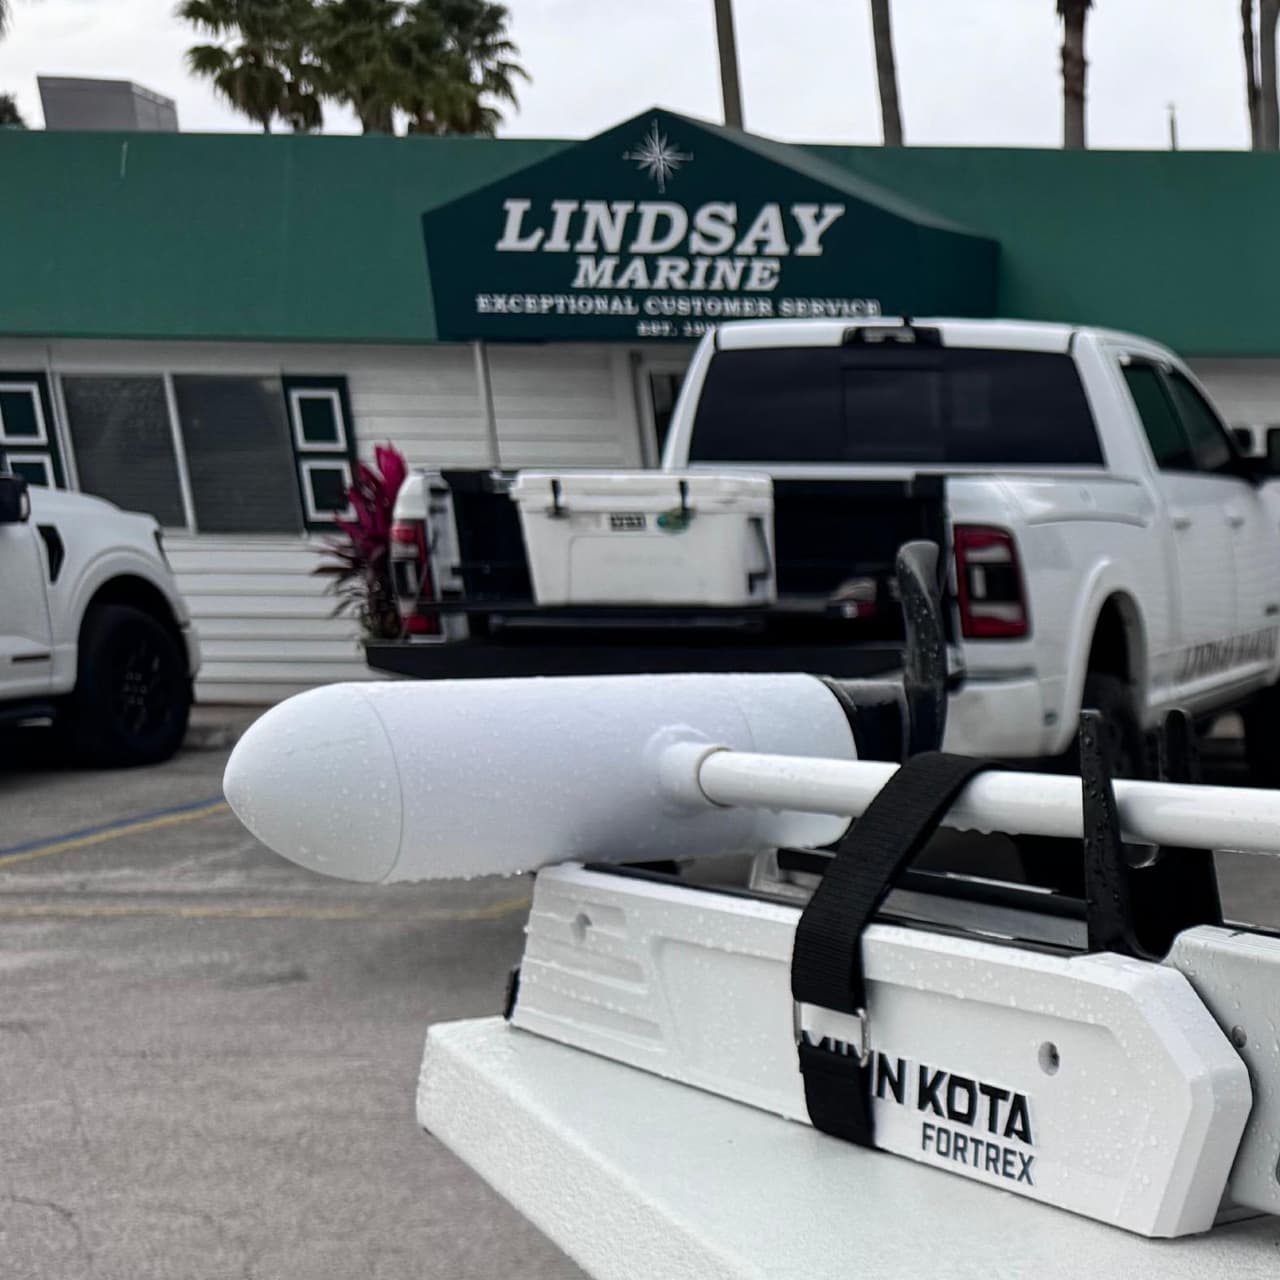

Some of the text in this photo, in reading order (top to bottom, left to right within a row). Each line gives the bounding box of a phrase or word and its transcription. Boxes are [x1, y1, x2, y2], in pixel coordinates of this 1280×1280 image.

[496, 198, 845, 257] LINDSAY
[572, 255, 780, 292] MARINE
[476, 294, 881, 318] EXCEPTIONAL CUSTOMER SERVICE
[917, 1063, 1034, 1146] KOTA
[922, 1120, 1035, 1187] FORTREX
